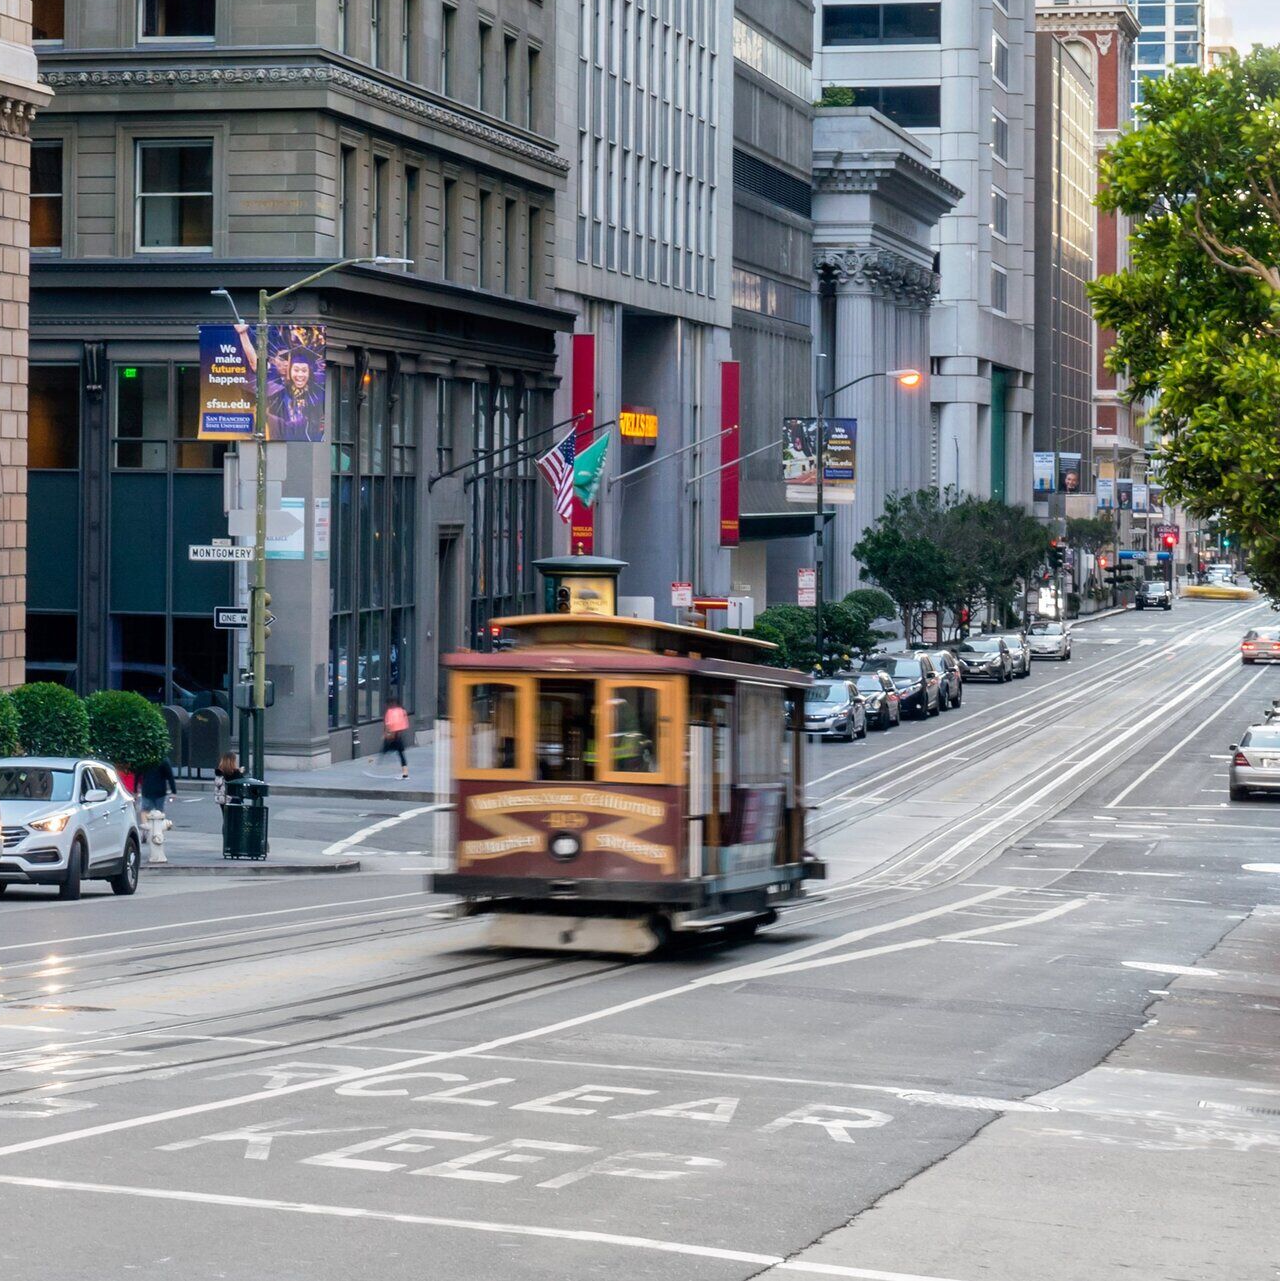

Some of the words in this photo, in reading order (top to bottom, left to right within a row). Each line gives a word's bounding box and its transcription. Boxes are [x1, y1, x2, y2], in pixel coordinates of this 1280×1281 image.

[220, 345, 237, 354] We
[215, 355, 242, 364] make
[211, 364, 246, 373] futures
[208, 374, 249, 386] happen.
[206, 399, 251, 409] sfsu.edu
[192, 548, 252, 558] MONTGOMERY
[221, 614, 237, 622] ONE
[335, 1072, 894, 1143] CLEAR
[152, 1119, 727, 1188] KEEP
